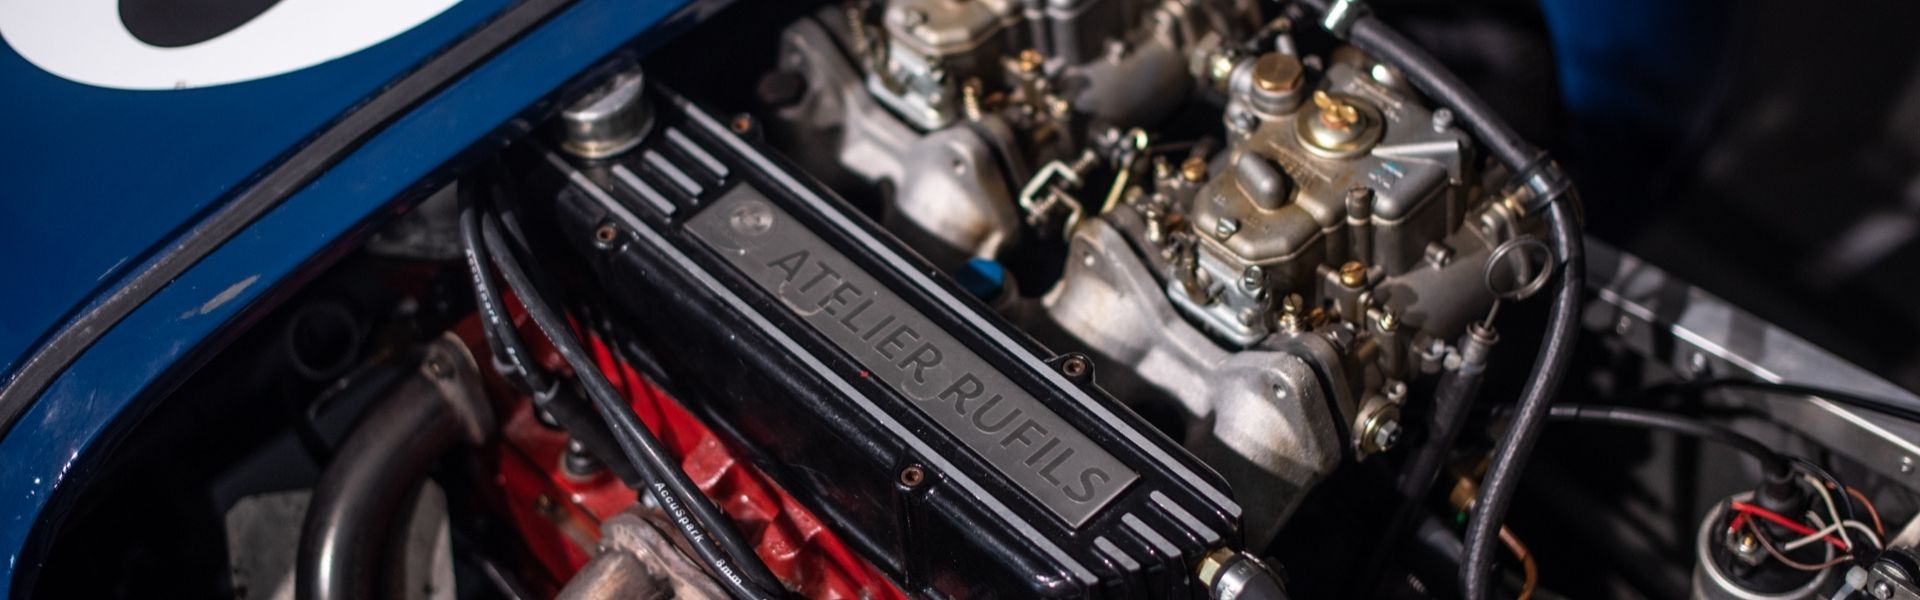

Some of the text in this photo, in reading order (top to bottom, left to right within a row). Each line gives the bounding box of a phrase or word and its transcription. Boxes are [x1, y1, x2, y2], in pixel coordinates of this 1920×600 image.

[768, 250, 1110, 504] ATELIER RUFILS
[654, 481, 742, 587] AccuSpark 8mm
